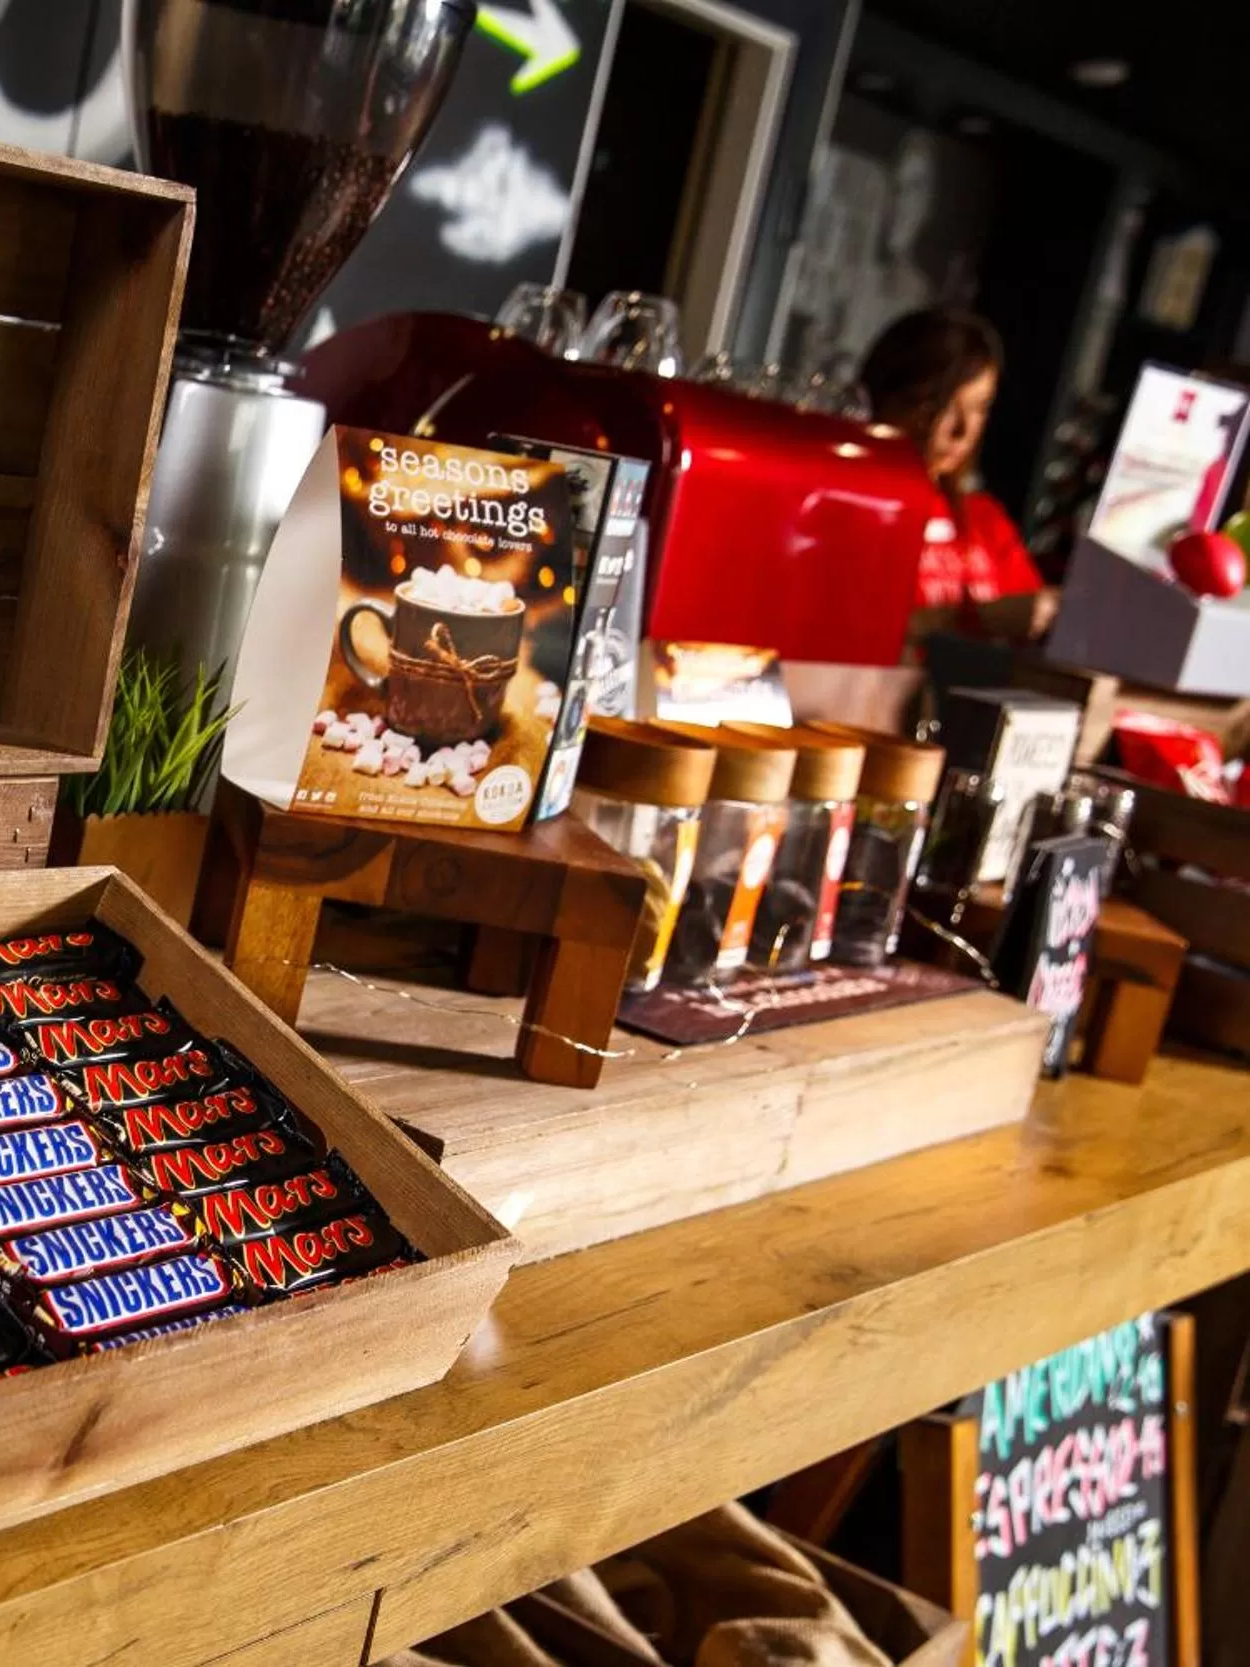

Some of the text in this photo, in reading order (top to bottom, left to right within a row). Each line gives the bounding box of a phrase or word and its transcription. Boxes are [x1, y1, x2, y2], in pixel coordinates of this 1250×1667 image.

[381, 447, 530, 494] seasons
[369, 480, 548, 537] greetings
[385, 521, 532, 552] to all hot chocolate lovers
[38, 1012, 171, 1063] Mars
[85, 1050, 215, 1110] Mars
[124, 1088, 258, 1151] Mars
[152, 1129, 286, 1198] Mars
[203, 1168, 338, 1243] Mars
[17, 1205, 187, 1279] SNICKERS
[244, 1213, 375, 1287] Mars
[52, 1256, 224, 1330] SNICKERS
